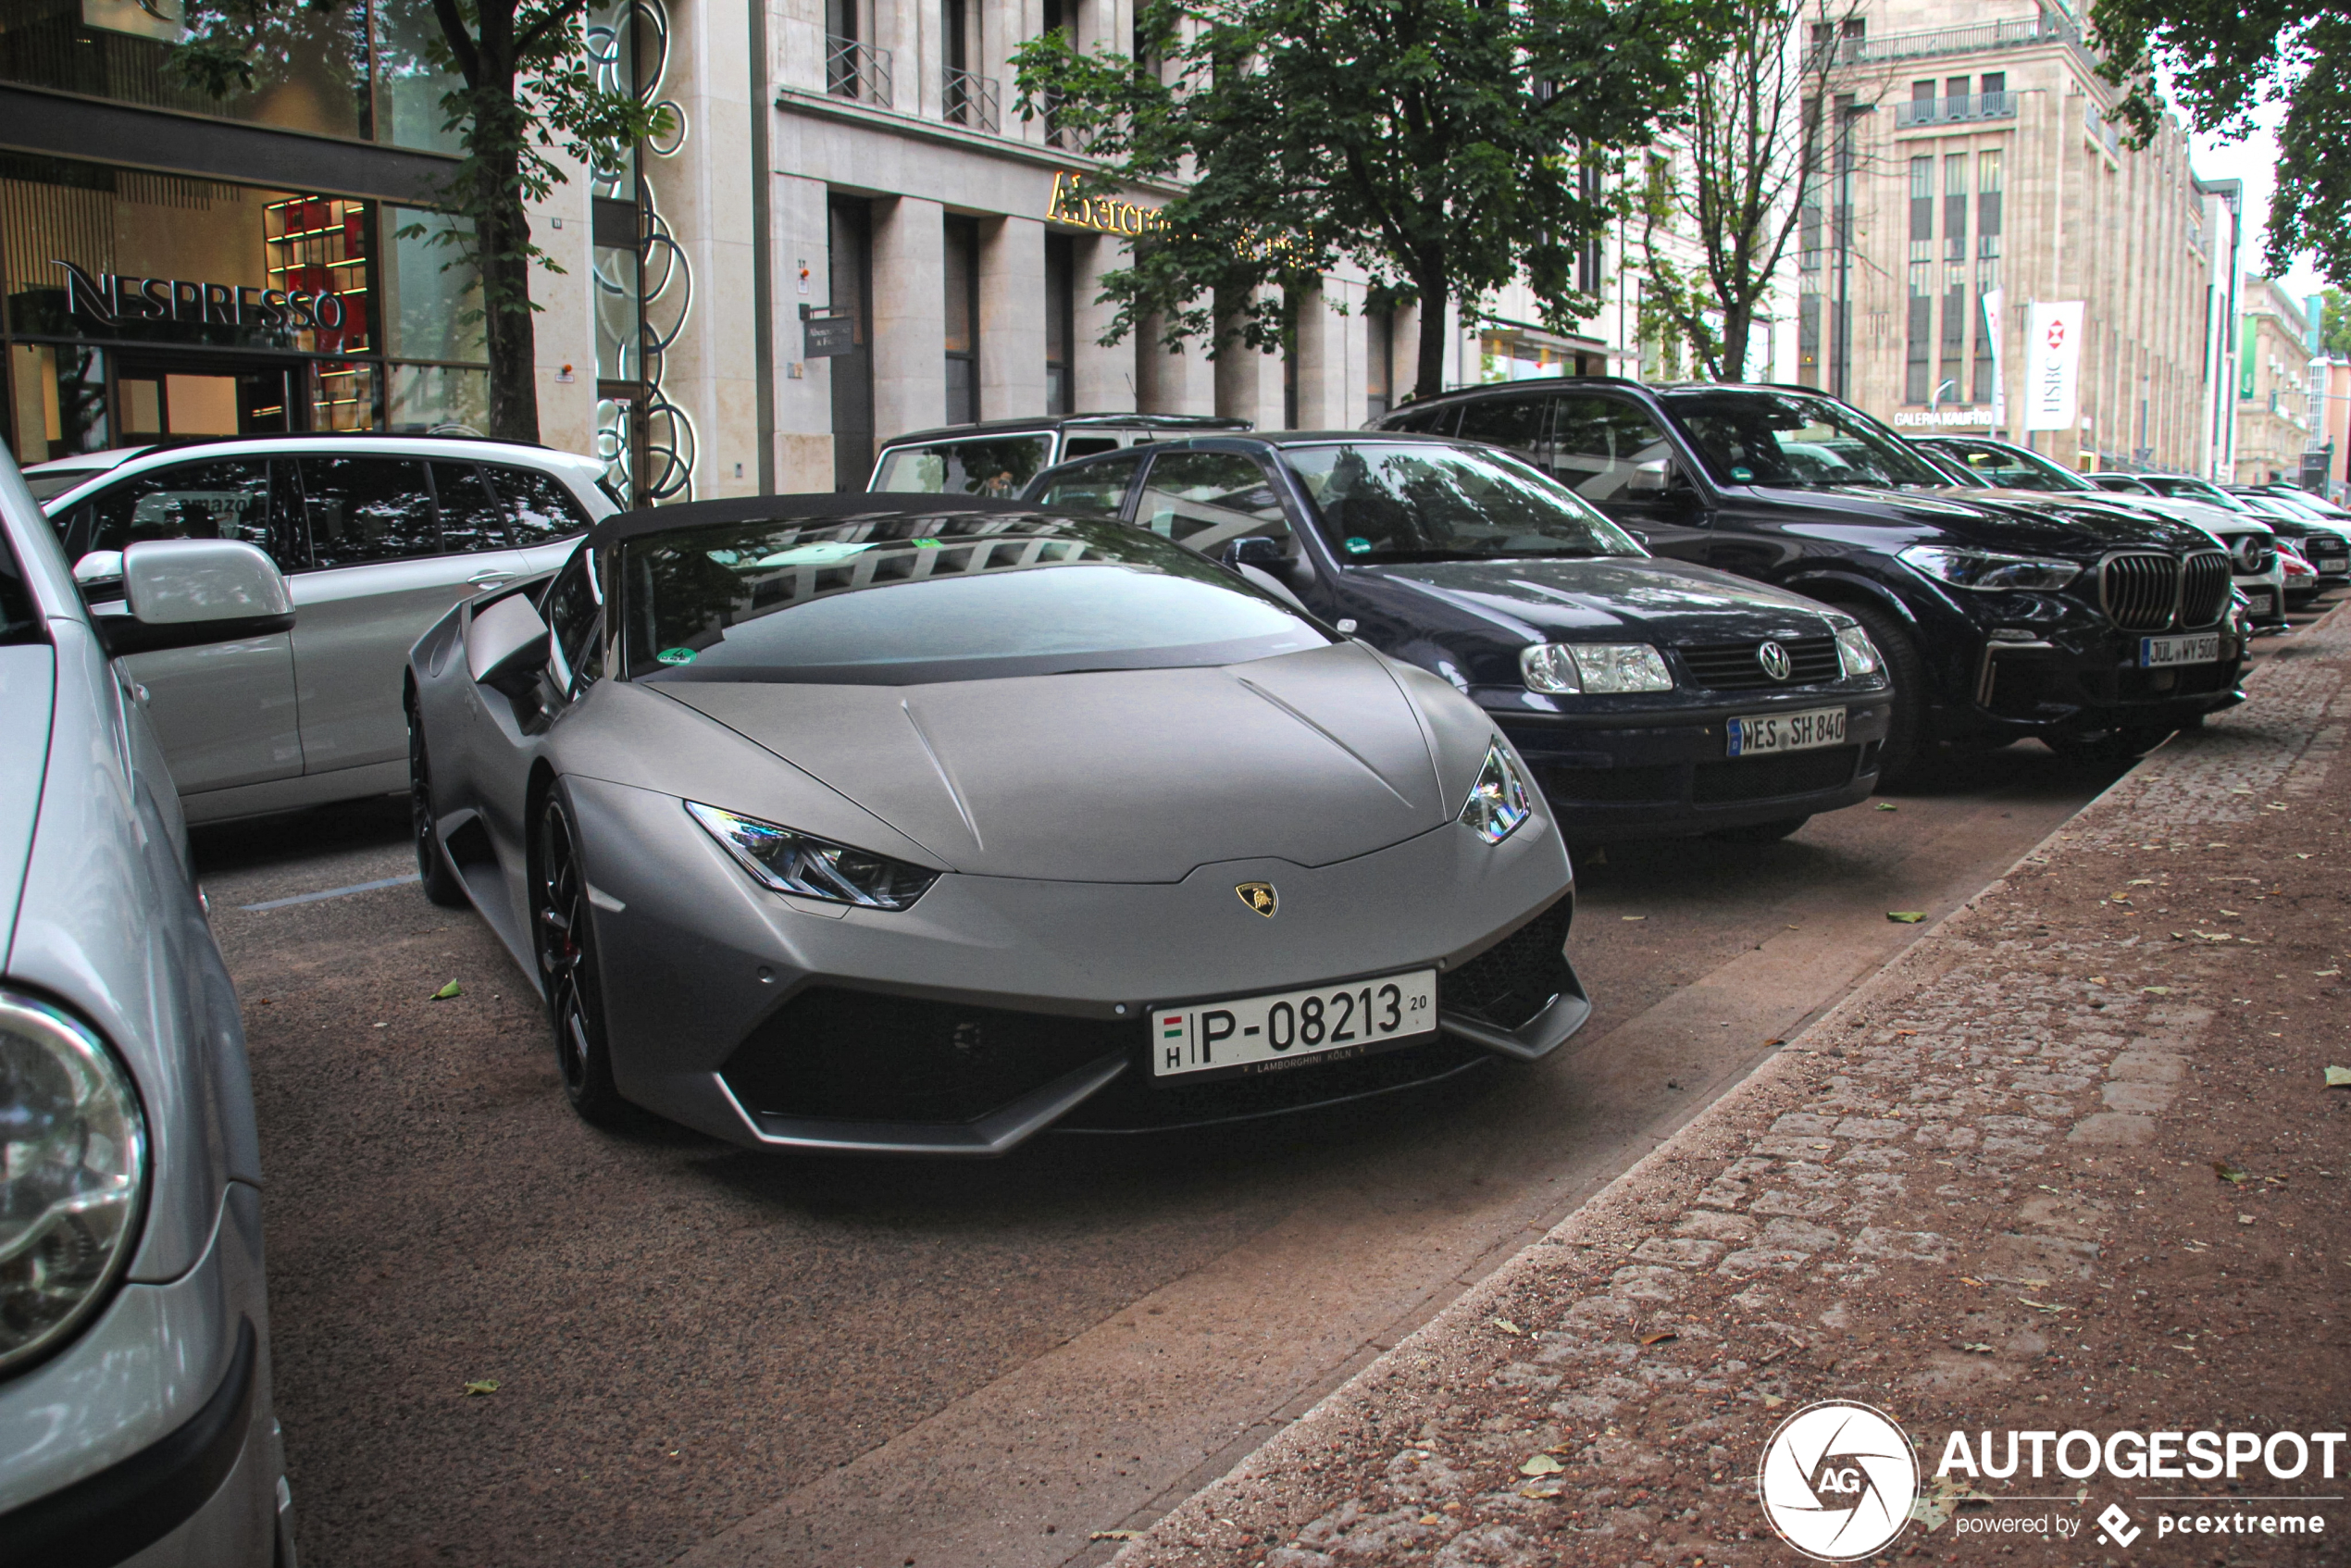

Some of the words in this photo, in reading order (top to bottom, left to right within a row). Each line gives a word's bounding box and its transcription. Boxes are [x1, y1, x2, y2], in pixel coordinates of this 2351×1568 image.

[50, 260, 347, 331] NESPRESSO
[2043, 356, 2063, 412] HSBC
[1894, 412, 1942, 427] GALERIA
[180, 498, 247, 514] mazo
[1741, 719, 1777, 750] WES
[1790, 716, 1812, 745] SH
[1166, 1047, 1181, 1069] H
[1201, 983, 1402, 1064] P-08213
[1410, 994, 1428, 1012] 20
[1256, 1054, 1323, 1074] LAMBORGHINI
[1326, 1047, 1352, 1062] KÖLN
